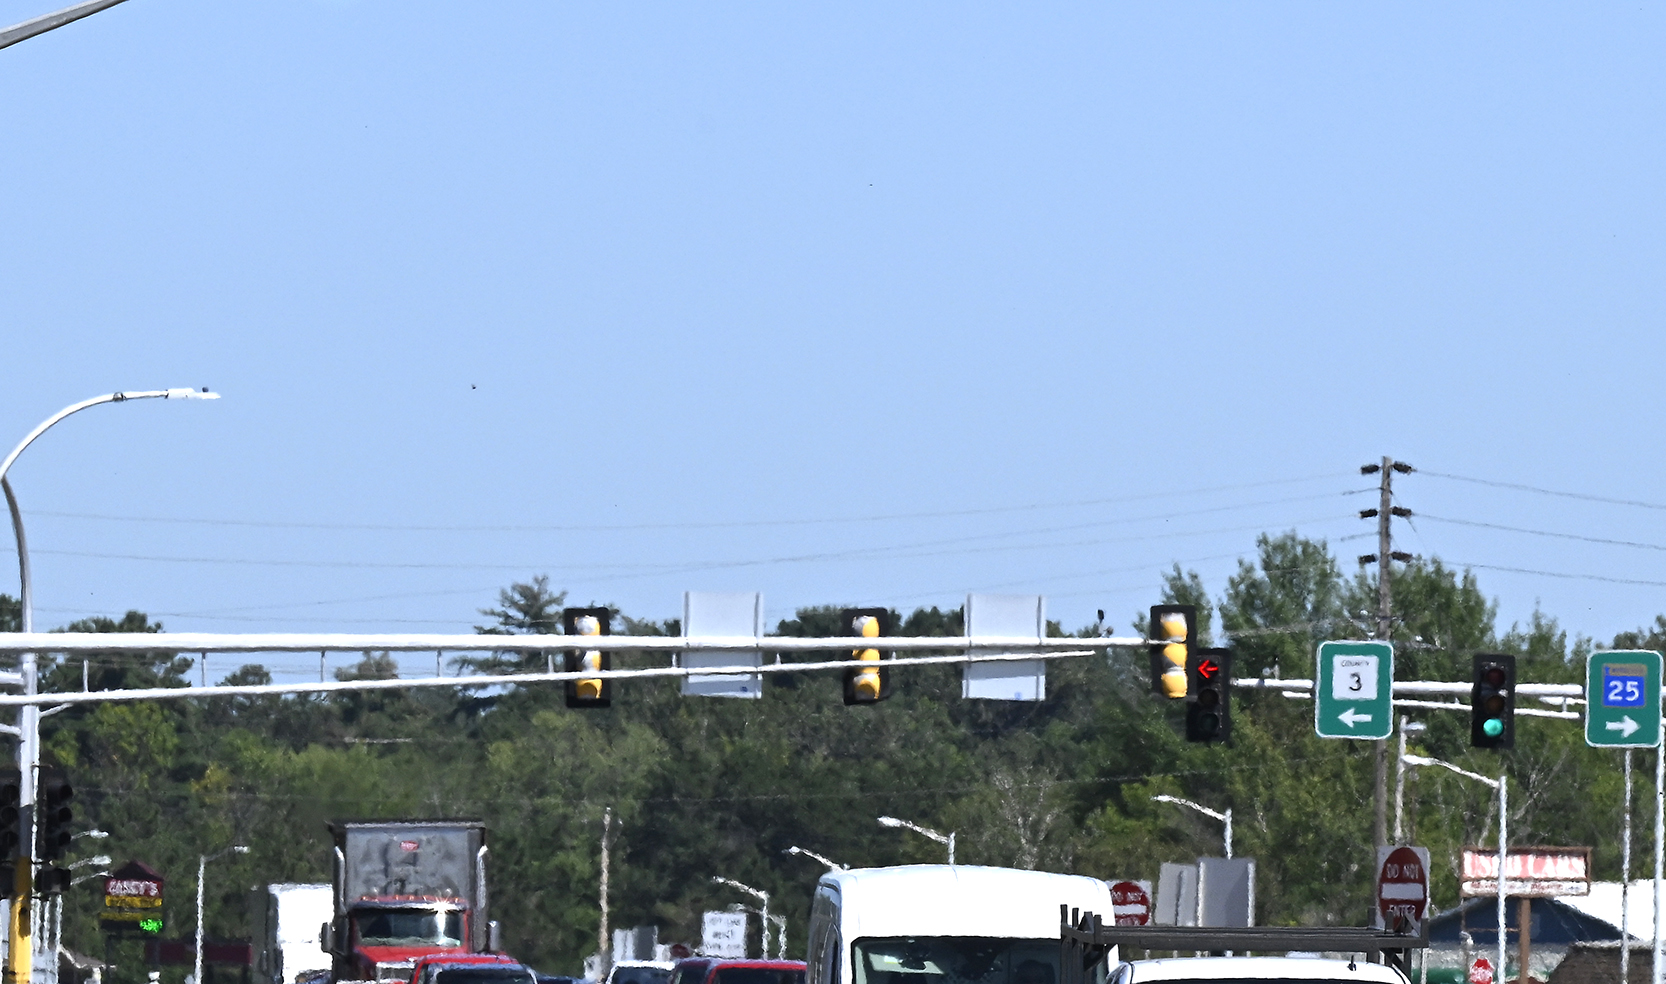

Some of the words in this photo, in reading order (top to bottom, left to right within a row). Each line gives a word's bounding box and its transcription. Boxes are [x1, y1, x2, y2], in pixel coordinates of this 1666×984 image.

[1349, 672, 1362, 692] 3
[1608, 680, 1640, 701] 25
[1386, 863, 1400, 879] DO
[1402, 863, 1419, 879] NOT
